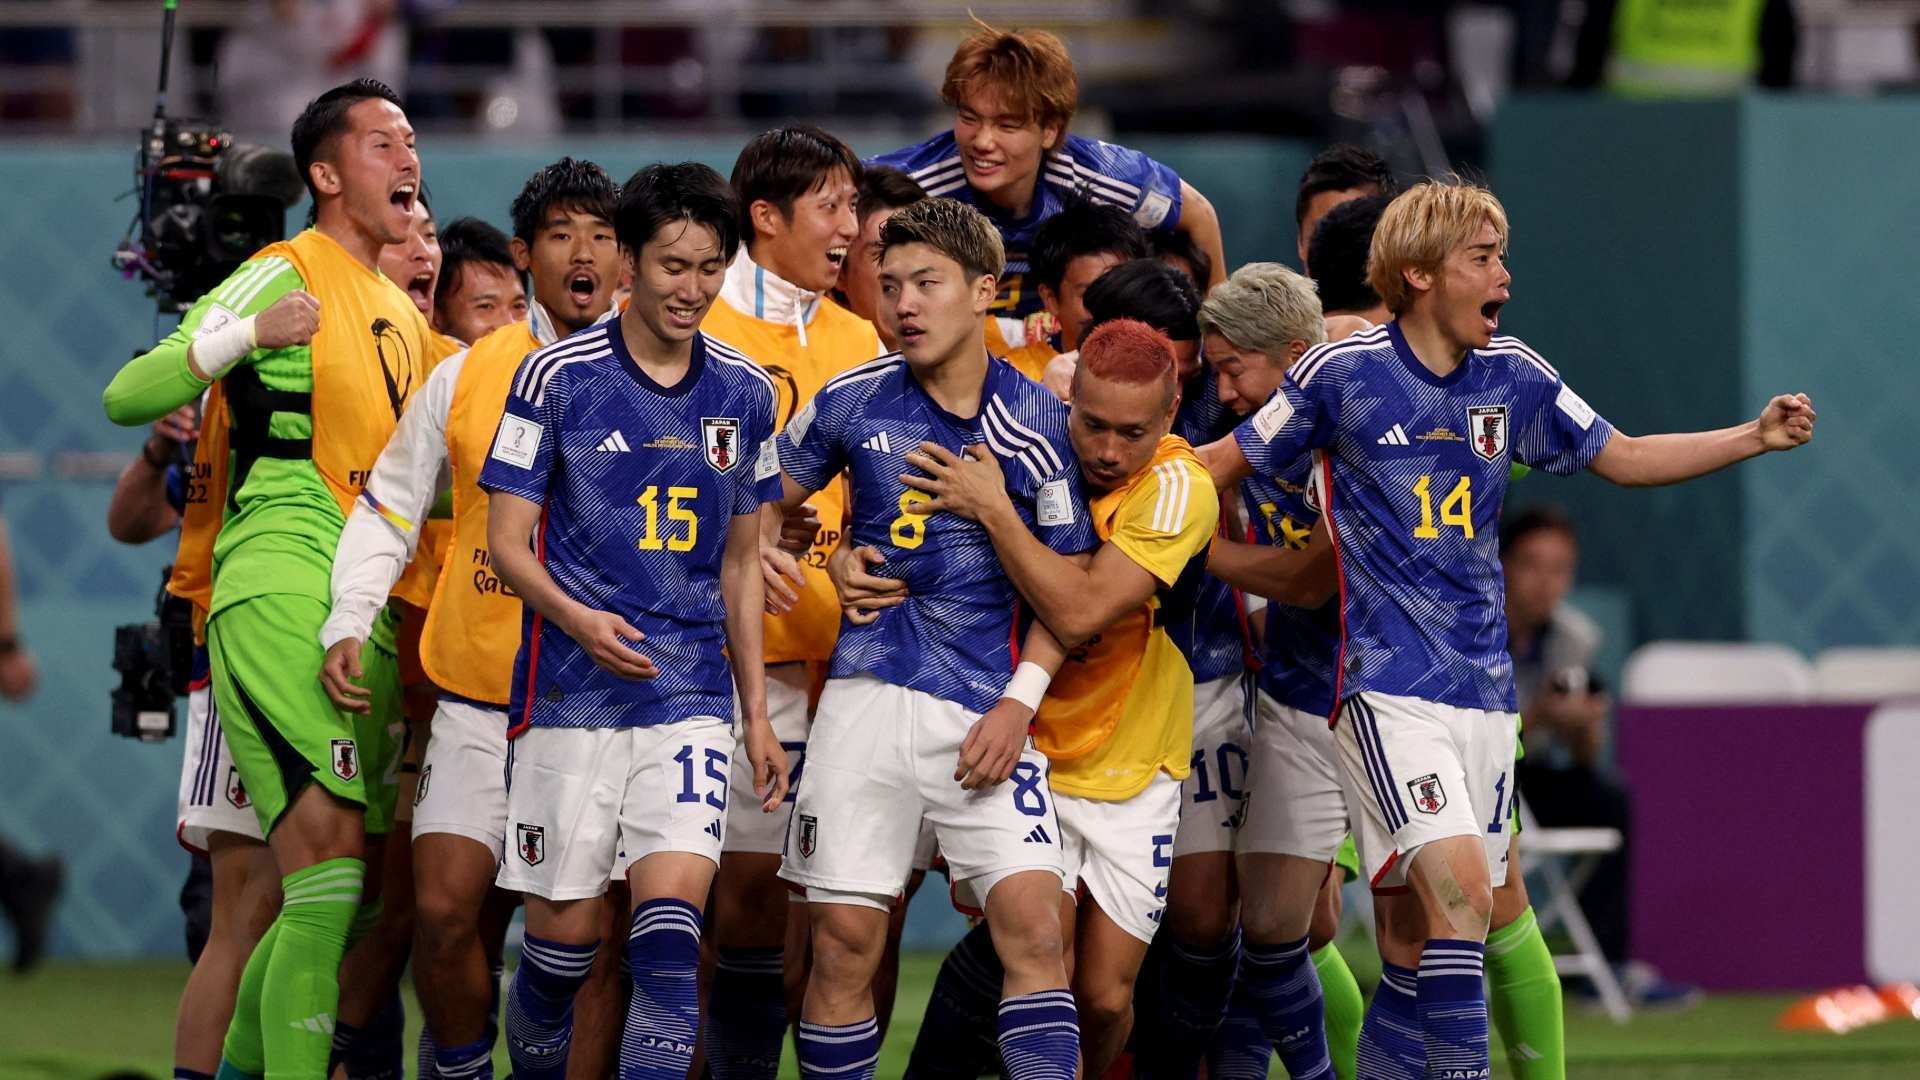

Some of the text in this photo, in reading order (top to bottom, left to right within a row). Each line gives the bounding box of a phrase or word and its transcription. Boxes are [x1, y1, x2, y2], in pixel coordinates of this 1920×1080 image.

[636, 485, 698, 552] 15
[890, 489, 931, 550] 8
[1413, 475, 1474, 539] 14
[472, 548, 490, 567] FI
[672, 744, 728, 812] 15
[1009, 761, 1047, 817] 8
[1189, 743, 1249, 804] 10
[513, 1038, 568, 1056] JAPA
[642, 1037, 695, 1056] JAPA
[1442, 1067, 1490, 1080] JAPA
